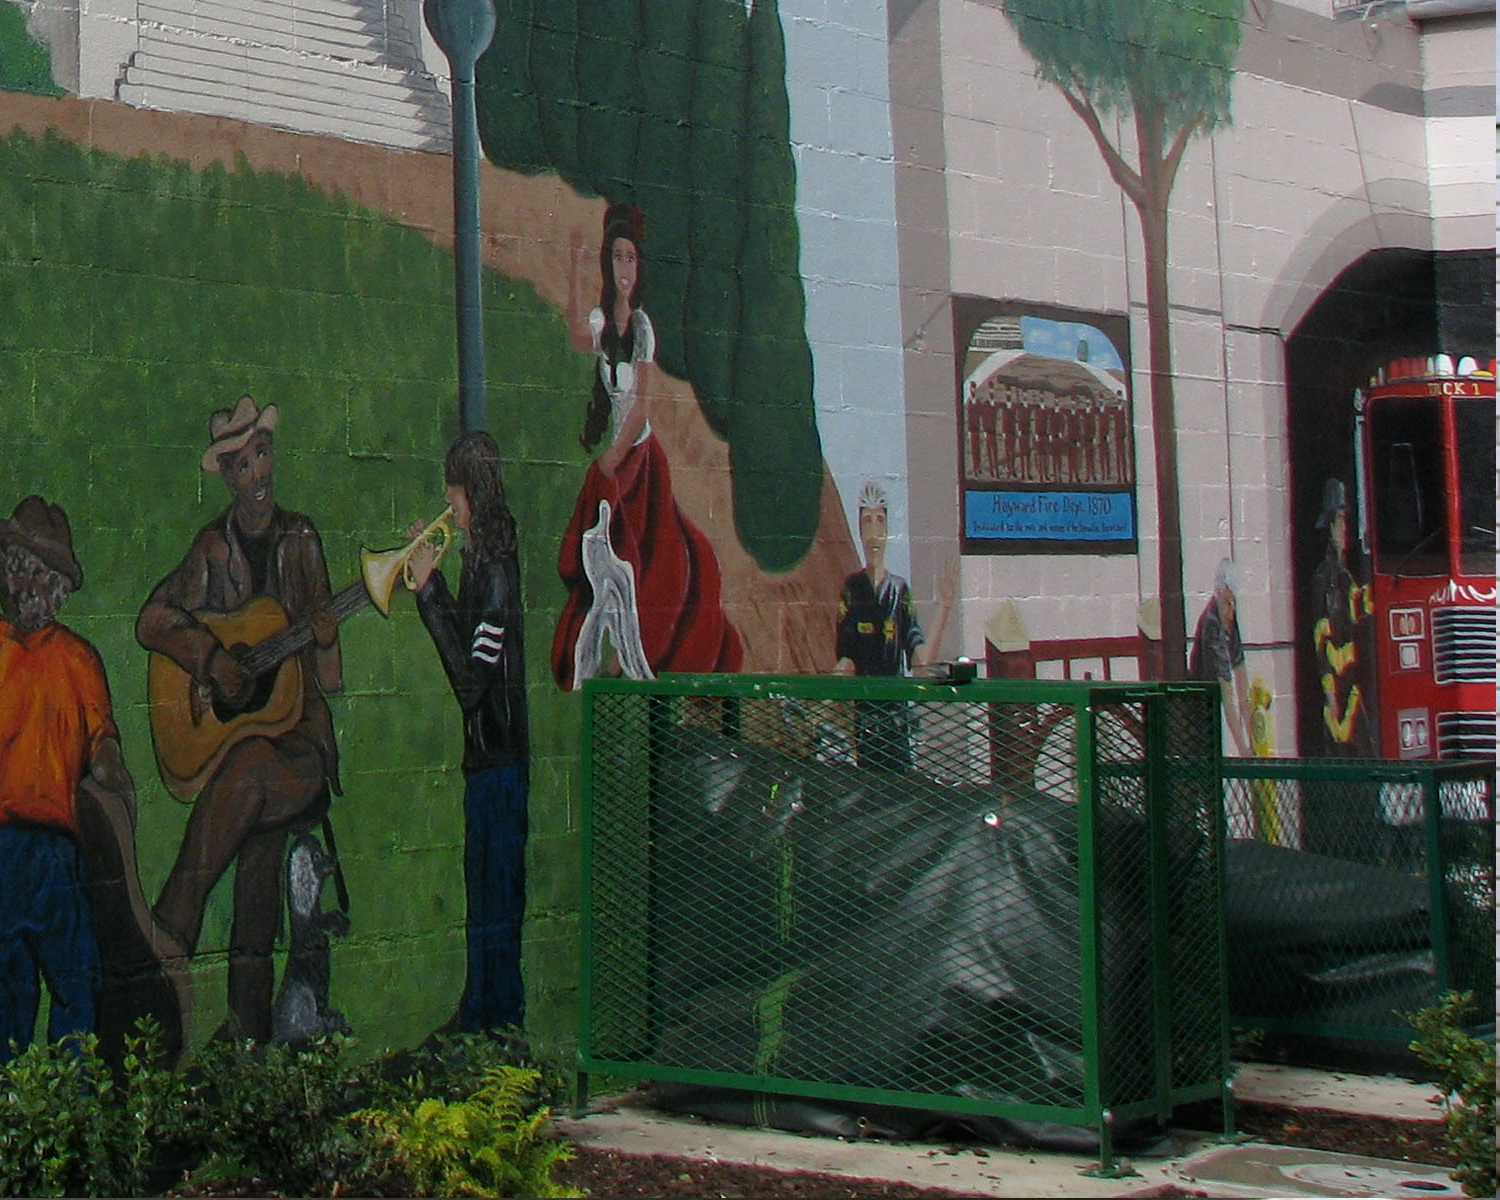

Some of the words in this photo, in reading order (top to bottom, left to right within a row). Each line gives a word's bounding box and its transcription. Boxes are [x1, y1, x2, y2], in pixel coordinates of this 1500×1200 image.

[1472, 382, 1481, 396] 1
[1038, 495, 1058, 513] Fire
[1088, 495, 1111, 515] 1870
